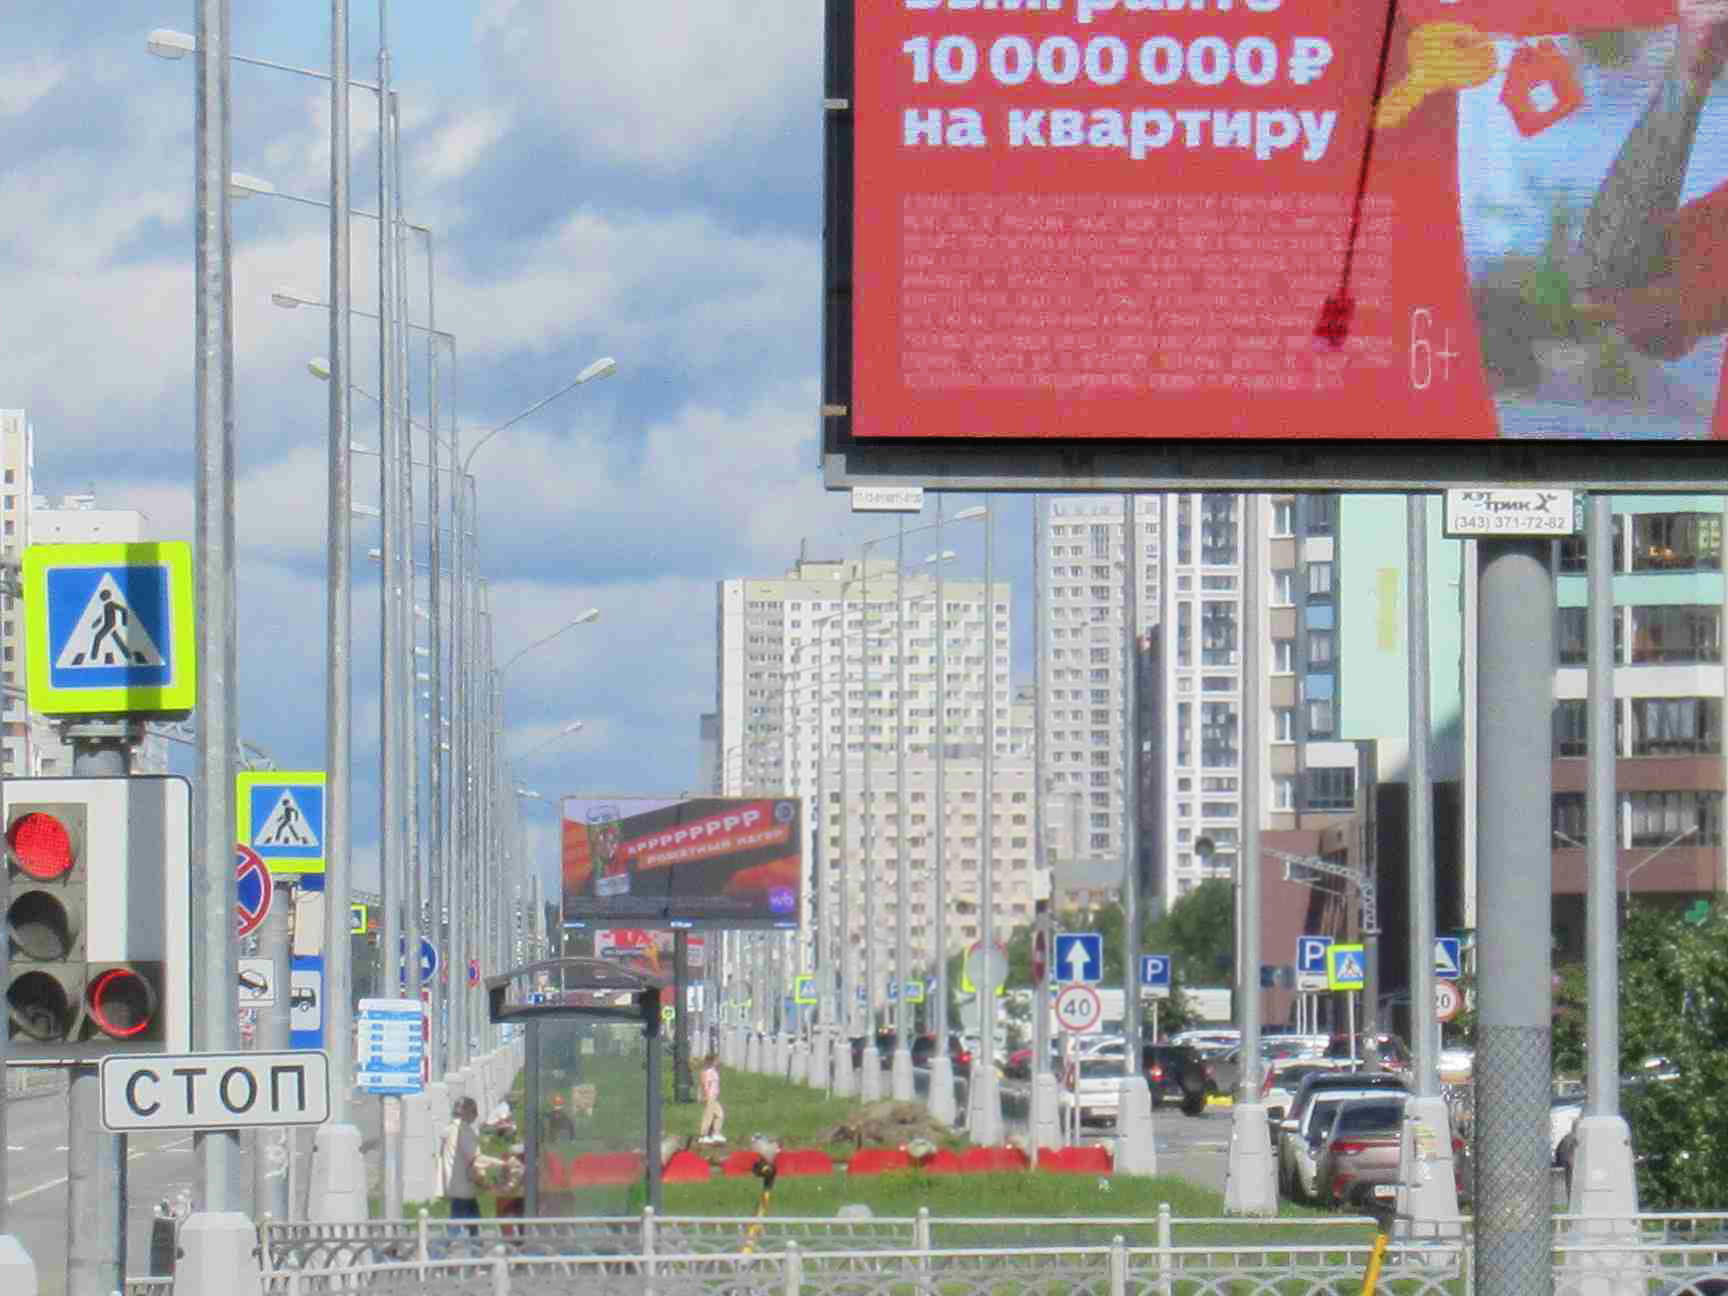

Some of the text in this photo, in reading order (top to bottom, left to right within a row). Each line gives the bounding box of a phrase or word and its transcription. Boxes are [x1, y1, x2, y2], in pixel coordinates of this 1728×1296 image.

[903, 35, 979, 85] 10
[903, 107, 1338, 162] на квартиру
[1409, 307, 1461, 390] 6+
[1454, 516, 1491, 530] (343)
[1063, 998, 1091, 1016] 40
[125, 1064, 305, 1117] СТОП
